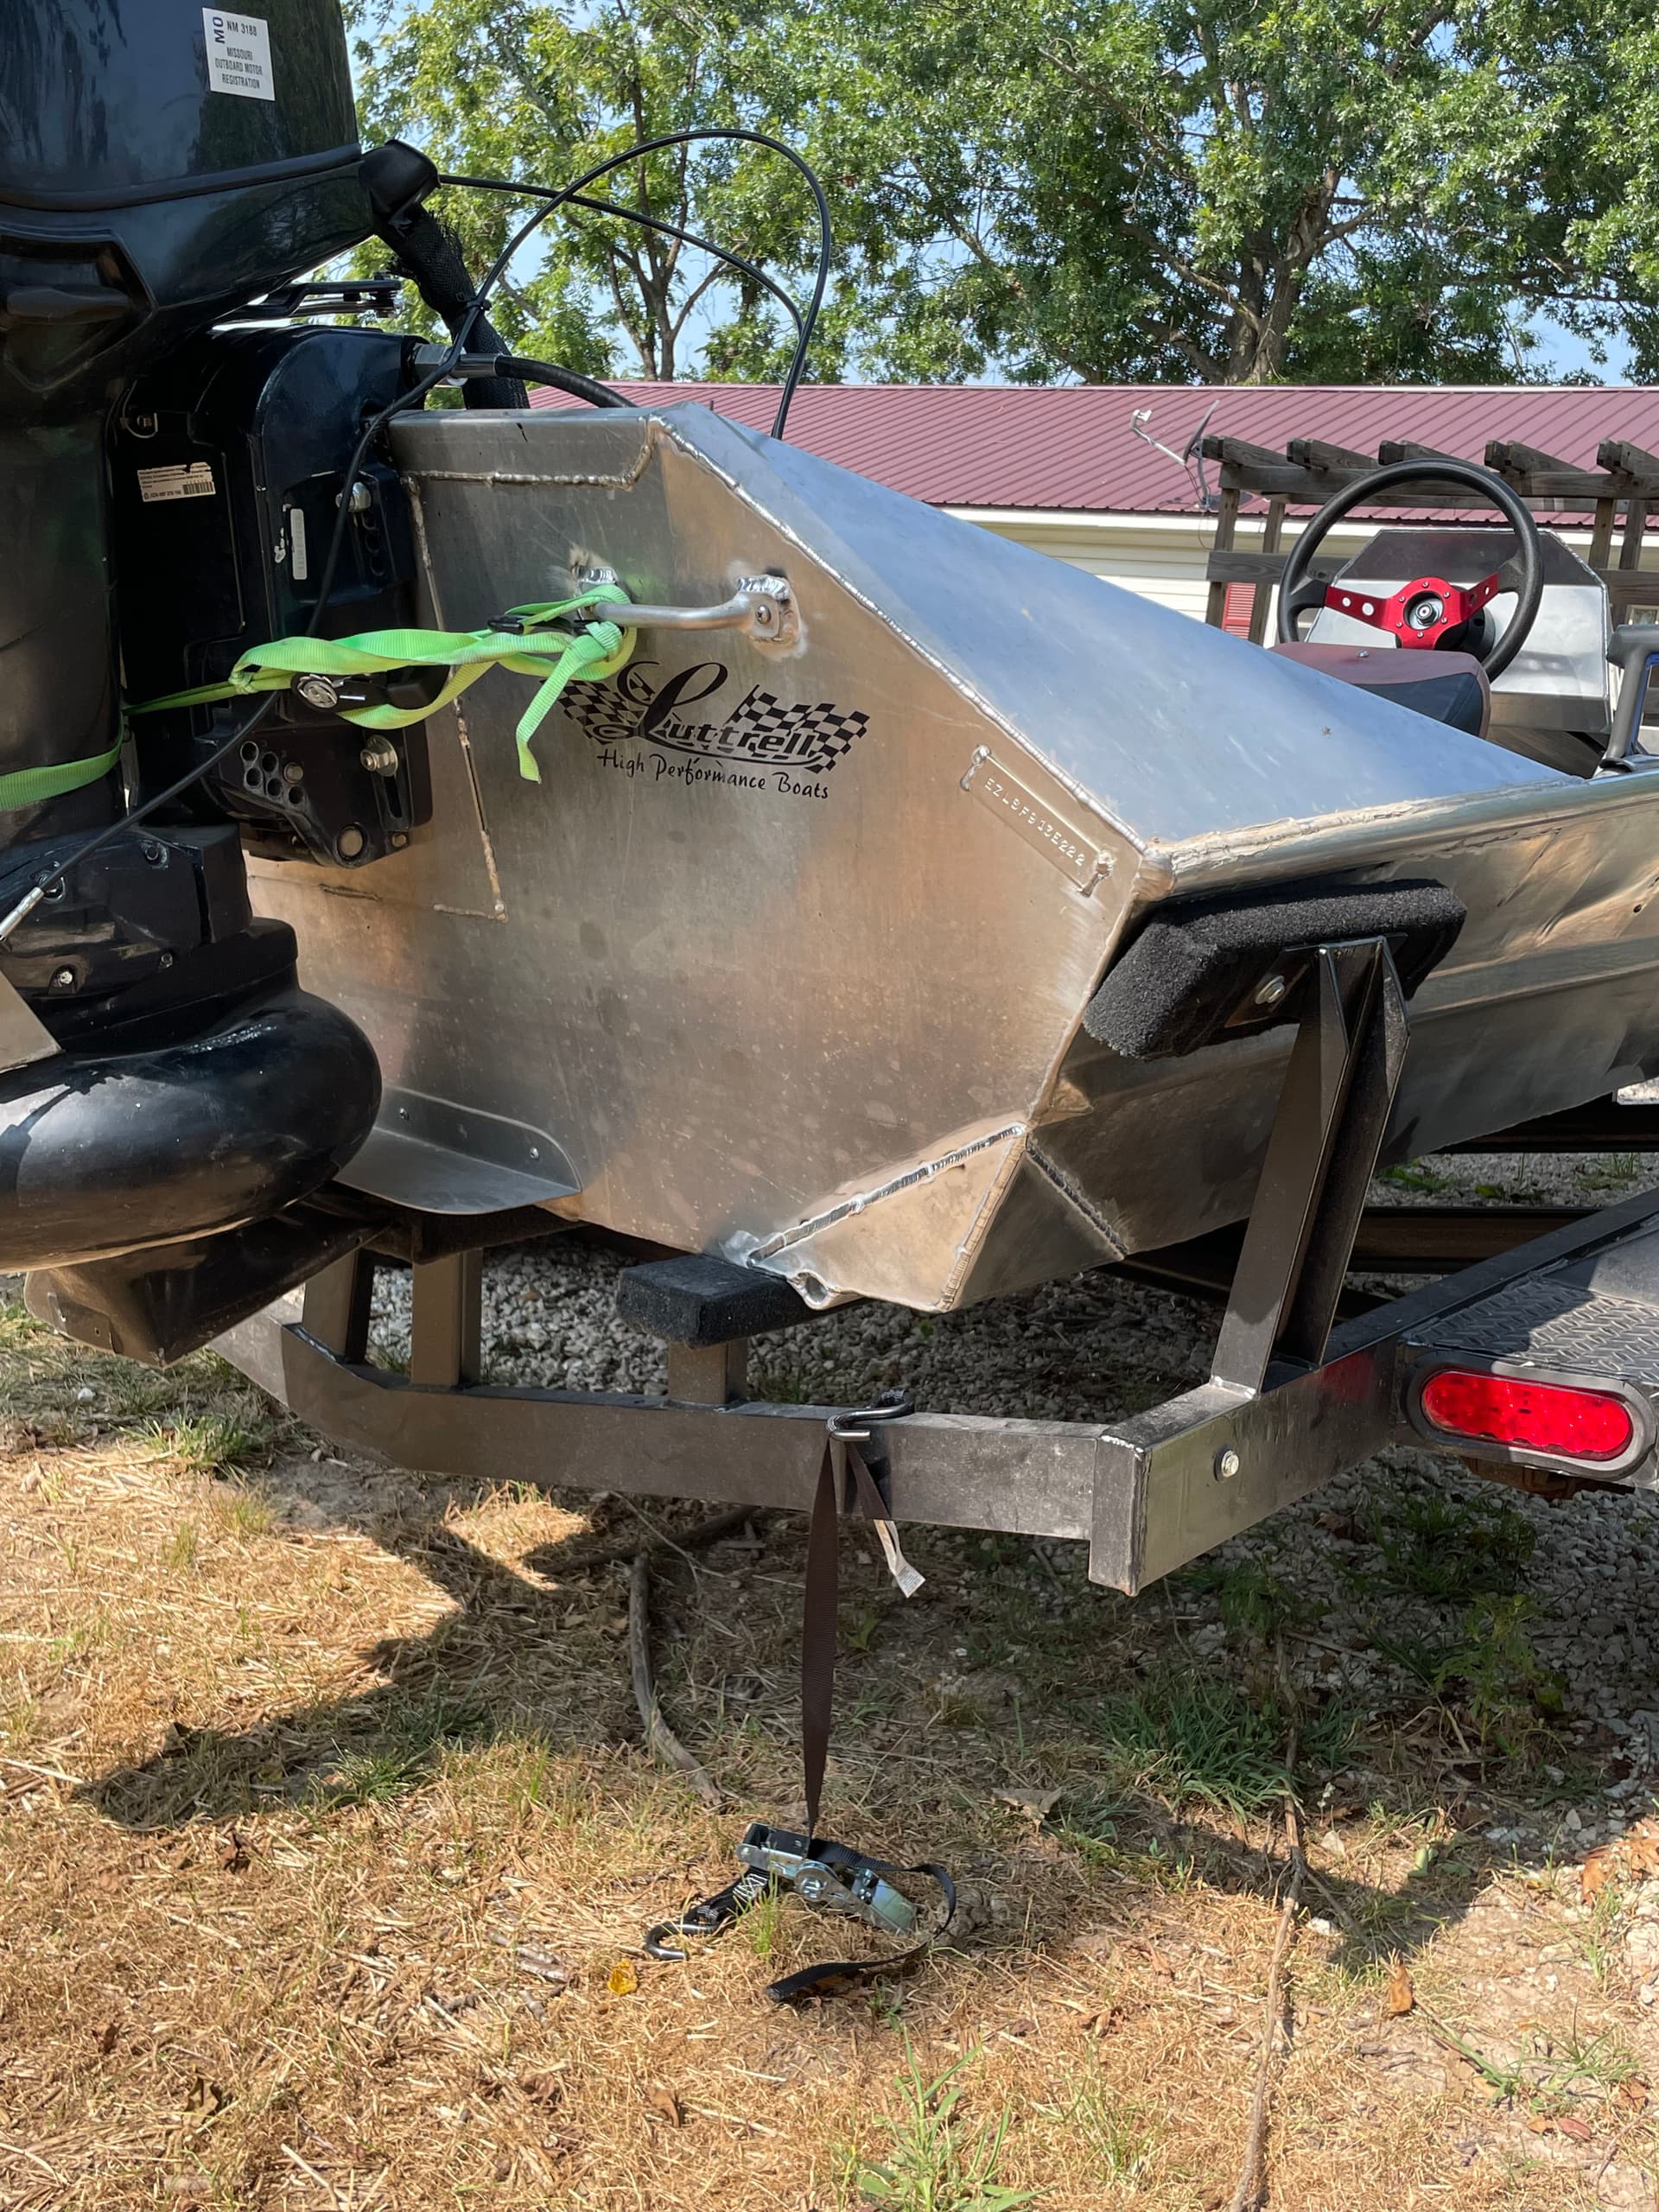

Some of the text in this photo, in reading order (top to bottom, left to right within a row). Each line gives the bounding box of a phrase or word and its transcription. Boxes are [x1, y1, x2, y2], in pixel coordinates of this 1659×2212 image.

[213, 16, 225, 44] MO
[226, 20, 238, 32] NM
[226, 47, 253, 60] MISSOURI
[214, 58, 263, 76] OUTBOARD MOTOR
[222, 73, 261, 88] REGISTRATION
[593, 661, 823, 766] Luttrell
[597, 748, 829, 798] High Performance Boats
